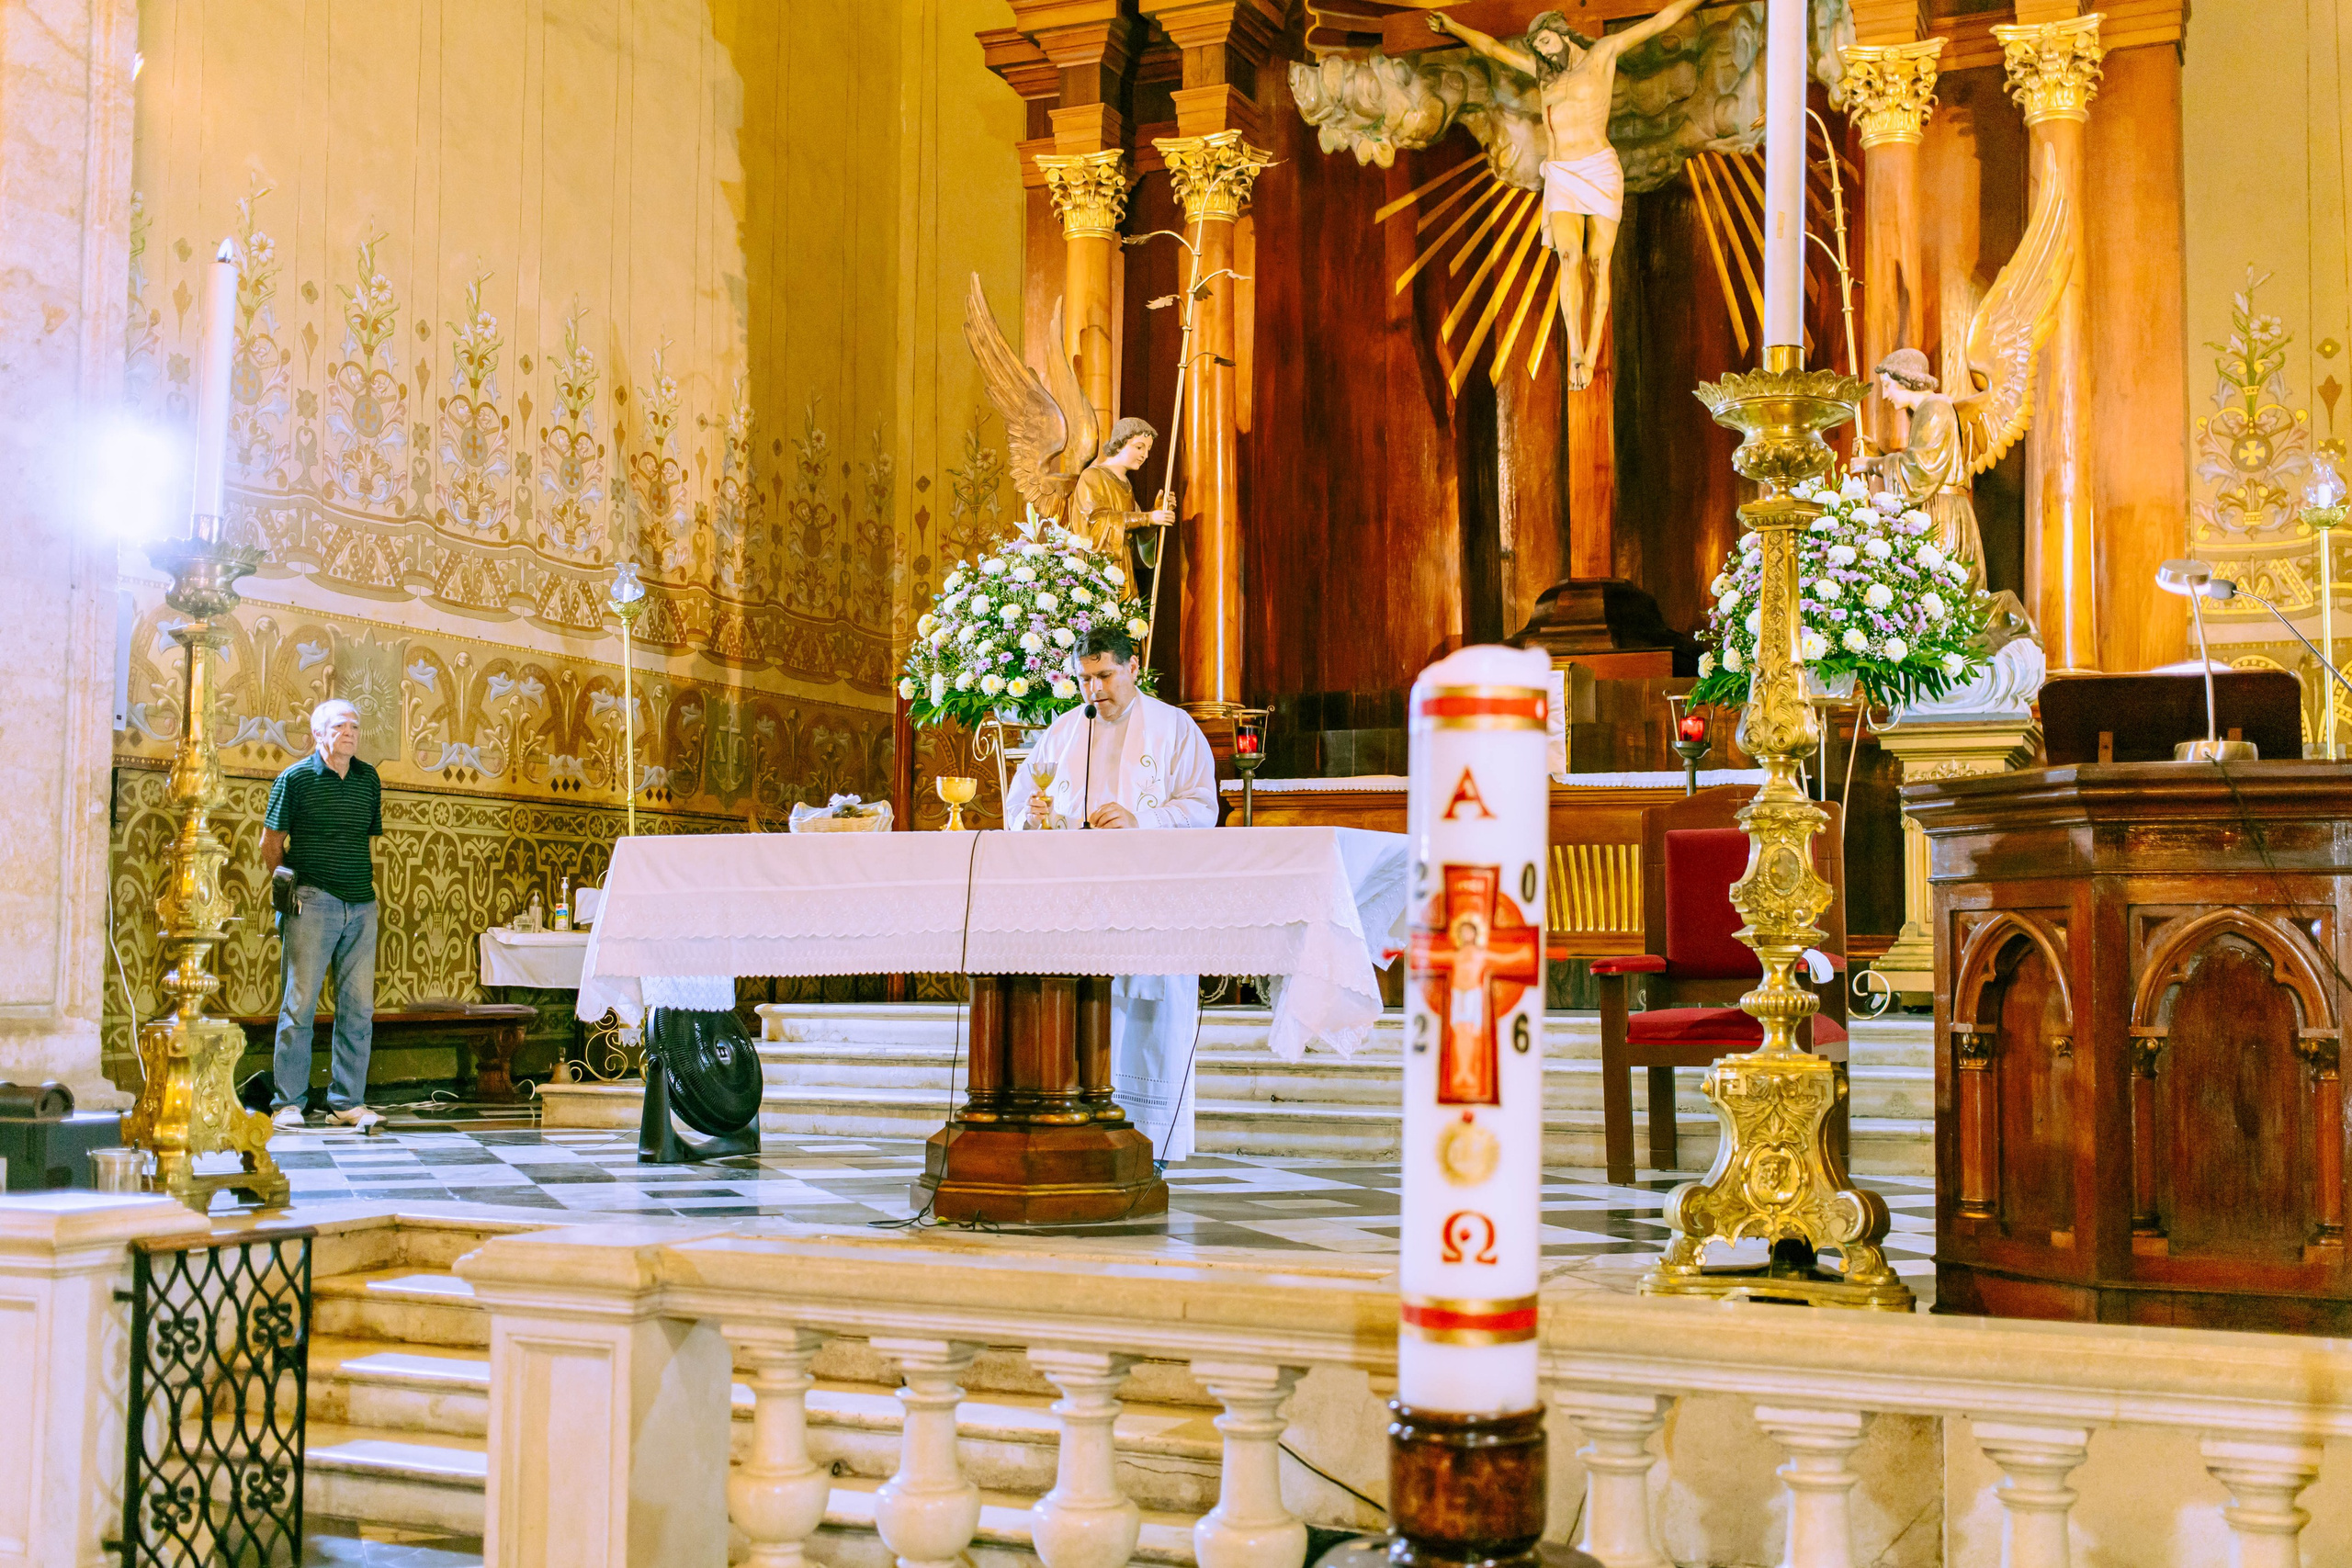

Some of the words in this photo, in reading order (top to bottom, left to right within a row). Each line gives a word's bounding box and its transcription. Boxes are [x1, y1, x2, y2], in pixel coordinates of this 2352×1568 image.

[1442, 767, 1497, 820] A
[1414, 1013, 1428, 1053] 2
[1513, 1012, 1530, 1054] 6
[1442, 1210, 1498, 1264] Ω
